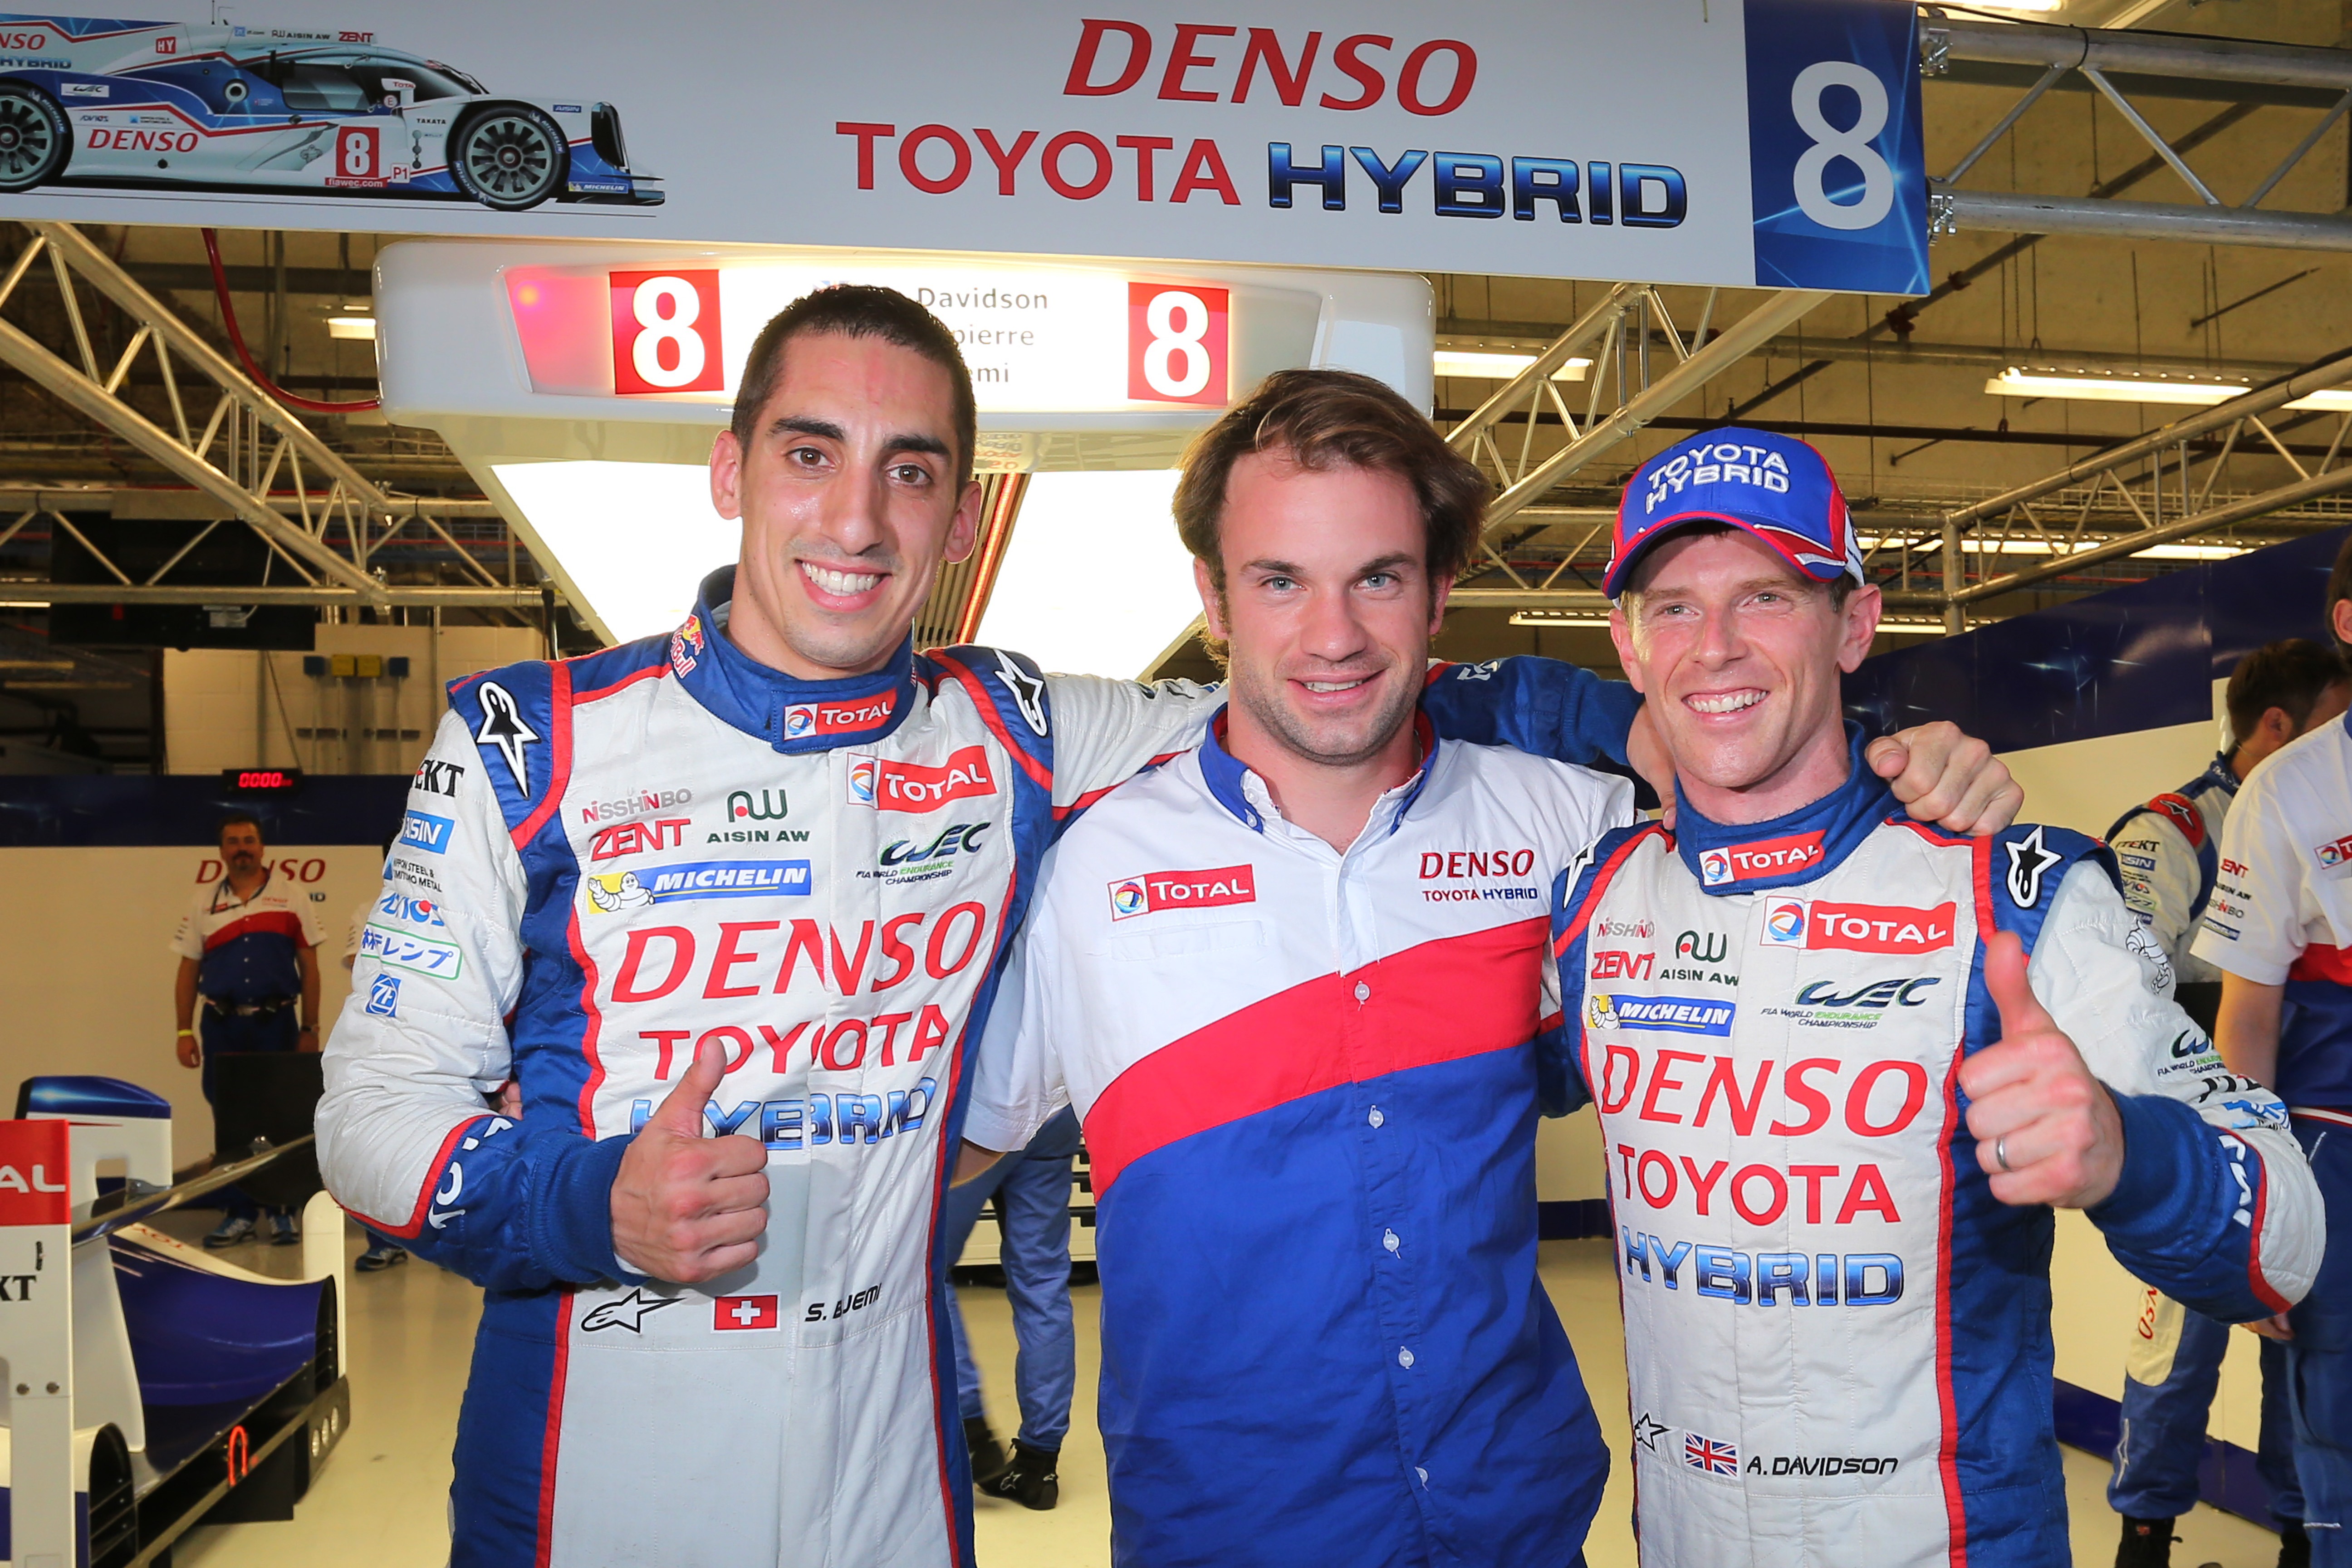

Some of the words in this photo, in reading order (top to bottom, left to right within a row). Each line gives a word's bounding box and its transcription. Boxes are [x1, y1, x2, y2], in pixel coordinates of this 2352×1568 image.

[0, 33, 46, 50] NSO
[158, 39, 175, 52] HY
[339, 31, 373, 43] ZENT
[1063, 18, 1478, 117] DENSO
[87, 128, 198, 152] DENSO
[541, 119, 564, 153] MICHELIN
[1790, 60, 1895, 231] 8
[345, 132, 370, 175] 8
[328, 178, 382, 188] fiawec.com
[393, 167, 407, 179] P1
[836, 121, 1241, 206] TOYOTA
[1267, 141, 1688, 229] HYBRID
[918, 288, 1048, 309] Davidson
[631, 275, 706, 387] 8
[953, 324, 1034, 346] pierre
[1143, 290, 1211, 397] 8
[1647, 443, 1790, 490] TOYOTA
[1646, 462, 1790, 515] HYBRID
[820, 700, 893, 726] TOTAL
[414, 760, 465, 798] EKT
[884, 760, 989, 803] TOTAL
[589, 818, 691, 861] ZENT
[706, 830, 769, 843] AISIN
[775, 830, 810, 842] AW
[879, 822, 991, 866] WEC
[899, 861, 954, 875] ENDURANCE
[1418, 848, 1535, 879] DENSO
[1733, 843, 1819, 871] TOTAL
[2221, 858, 2249, 878] ENT
[195, 859, 326, 884] DSO
[408, 862, 428, 876] STEEL
[429, 869, 435, 878] &
[653, 867, 808, 892] MICHELIN
[885, 870, 952, 885] CHAMPIONSHIP
[419, 877, 443, 893] METAL
[1152, 878, 1250, 901] TOTAL
[1421, 888, 1480, 902] TOYOTA
[1483, 887, 1538, 900] HYBRID
[1816, 912, 1948, 944] TOTAL
[611, 901, 985, 1003] DENSO
[1592, 951, 1656, 980] ZENT
[1660, 969, 1703, 981] AISIN
[1709, 973, 1739, 986] AW
[1795, 977, 1942, 1008] WEC
[1619, 1002, 1732, 1025] MICHELIN
[1780, 1009, 1814, 1018] WORLD
[1814, 1011, 1883, 1020] ENDURANCE
[1798, 1018, 1877, 1029] CHAMPIONSHIP
[639, 1004, 949, 1080] TOYOTA
[2158, 1063, 2171, 1076] FIA
[1602, 1044, 1928, 1137] DENSO
[1617, 1143, 1901, 1226] TOYOTA
[1622, 1225, 1903, 1307] HYBRID
[804, 1302, 827, 1322] S.
